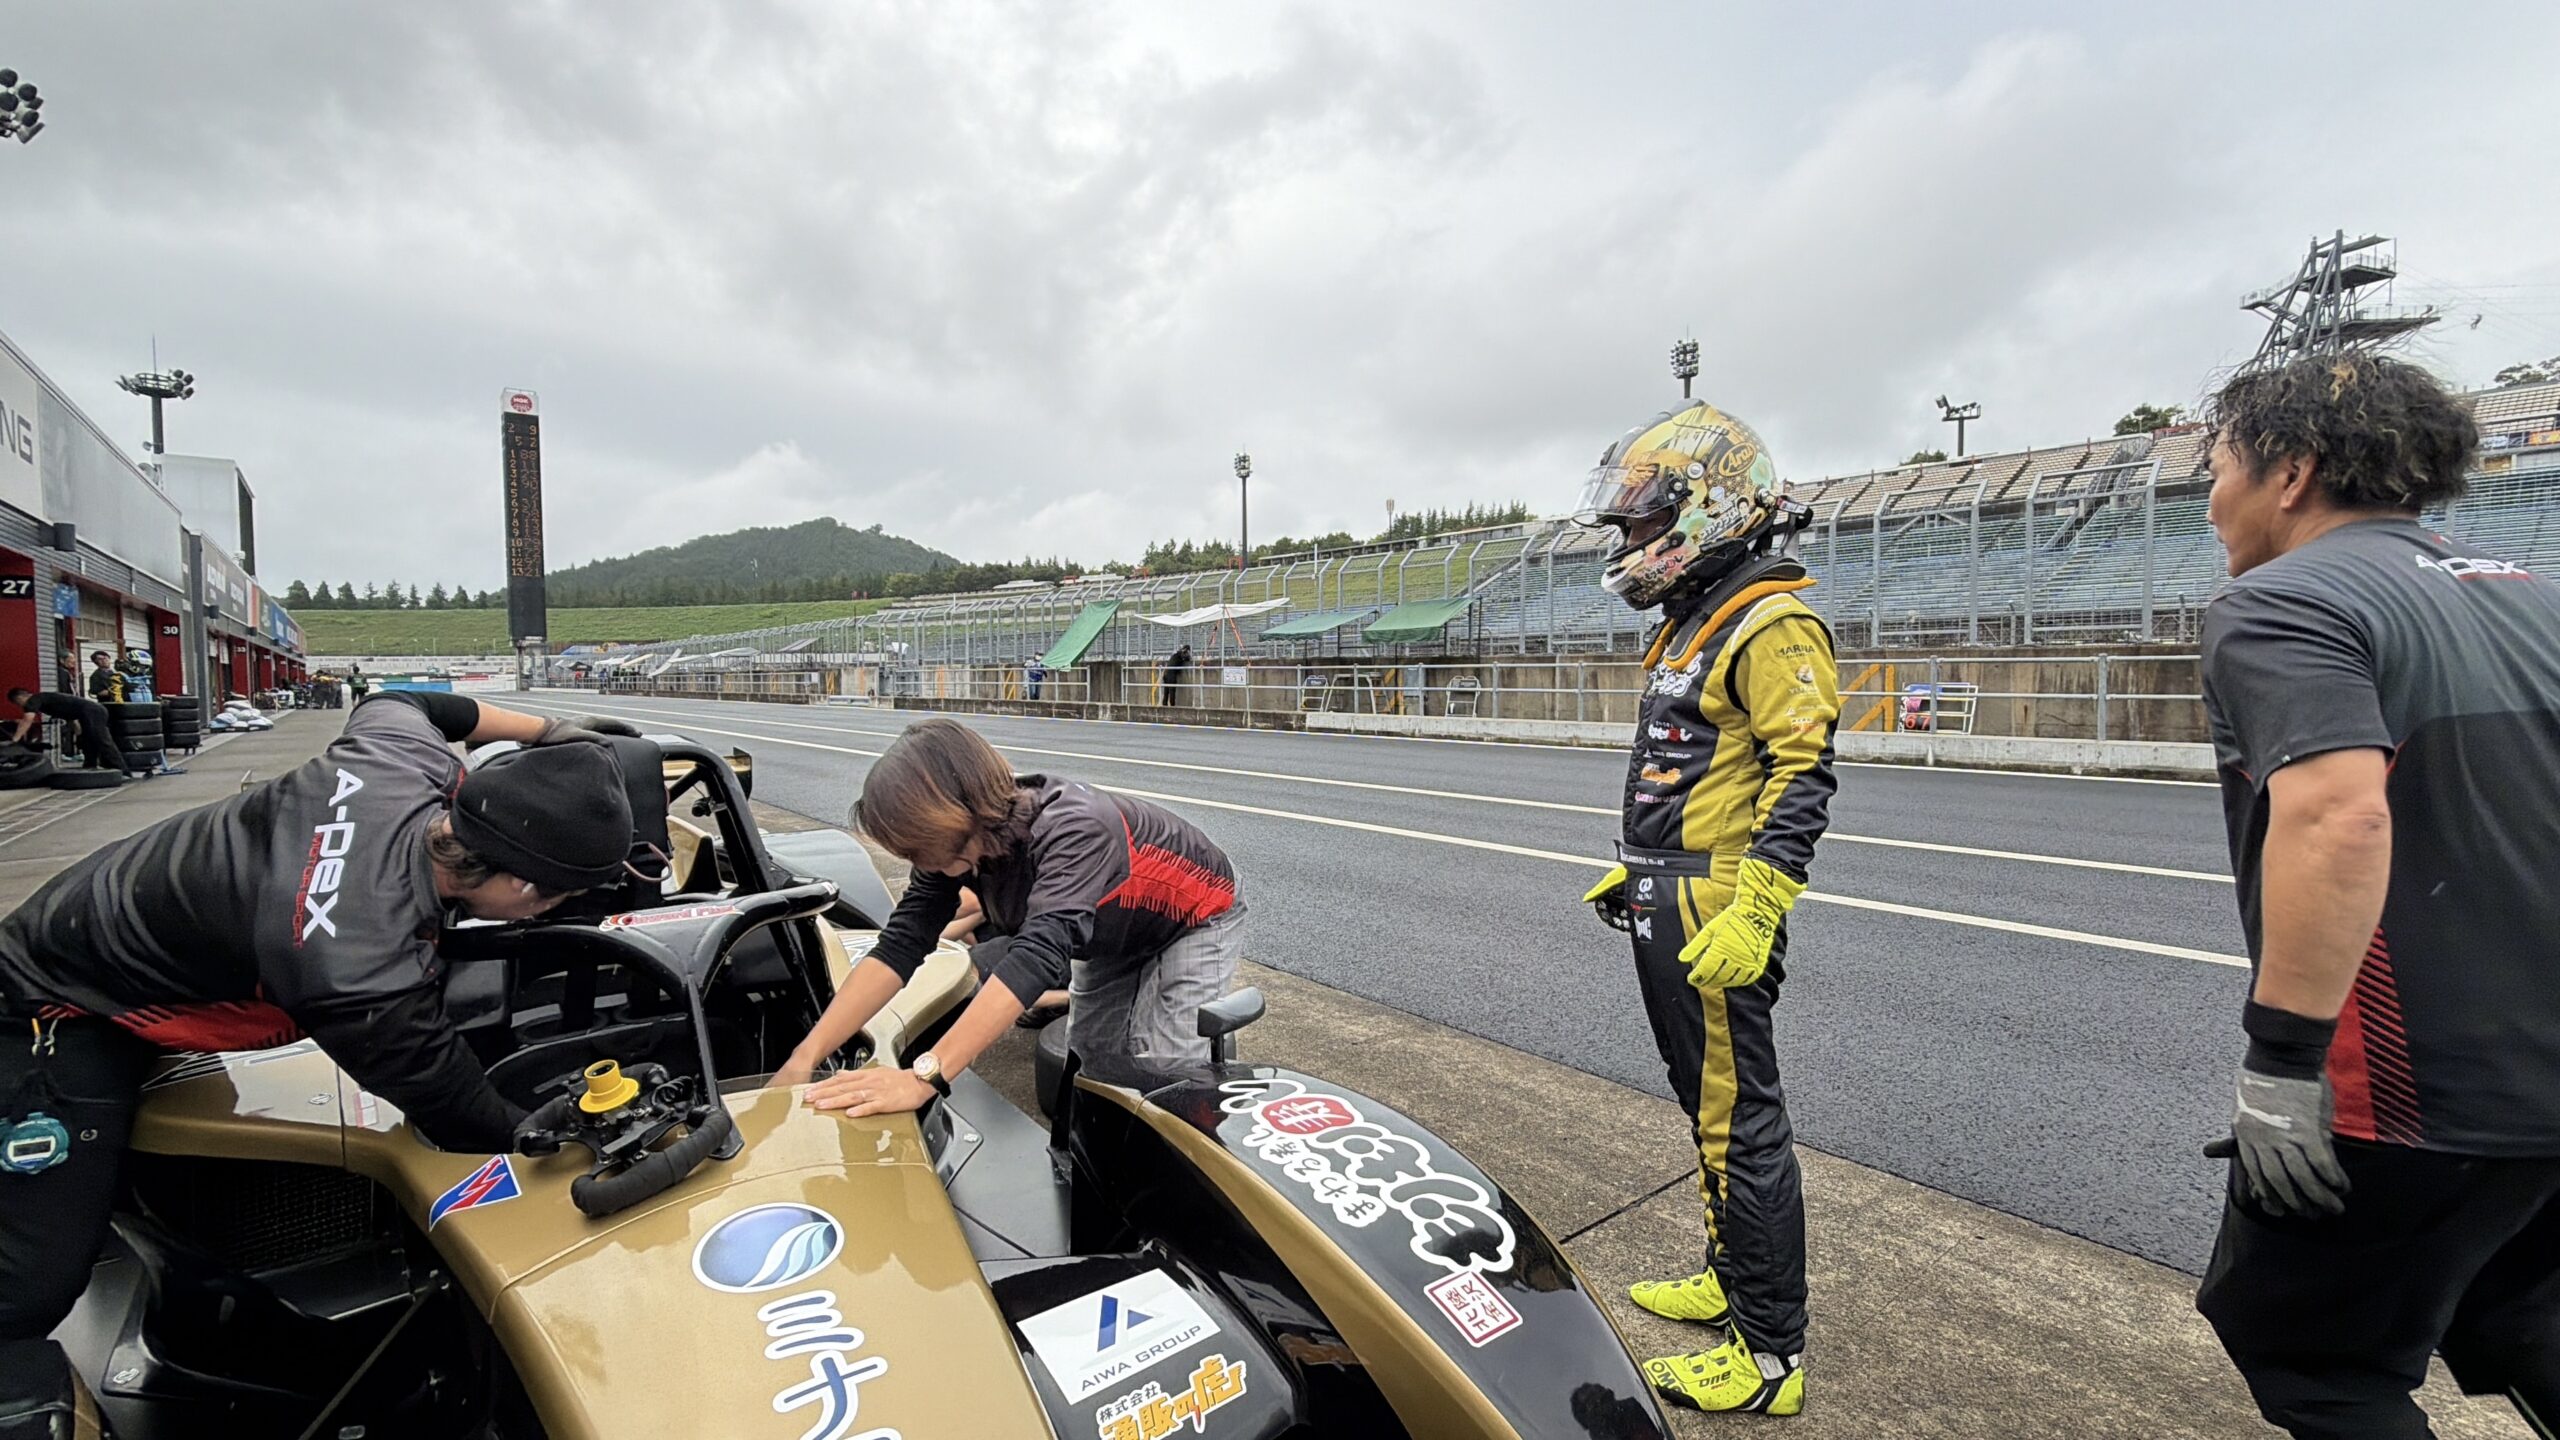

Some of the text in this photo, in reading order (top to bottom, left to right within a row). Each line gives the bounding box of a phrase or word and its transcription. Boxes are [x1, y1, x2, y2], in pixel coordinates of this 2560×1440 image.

[2, 579, 31, 595] 27
[163, 625, 178, 635] 30
[1221, 1080, 1509, 1269] もりもり寿し
[1081, 1325, 1201, 1391] AIWA GROUP
[1099, 1383, 1160, 1423] 株式会社
